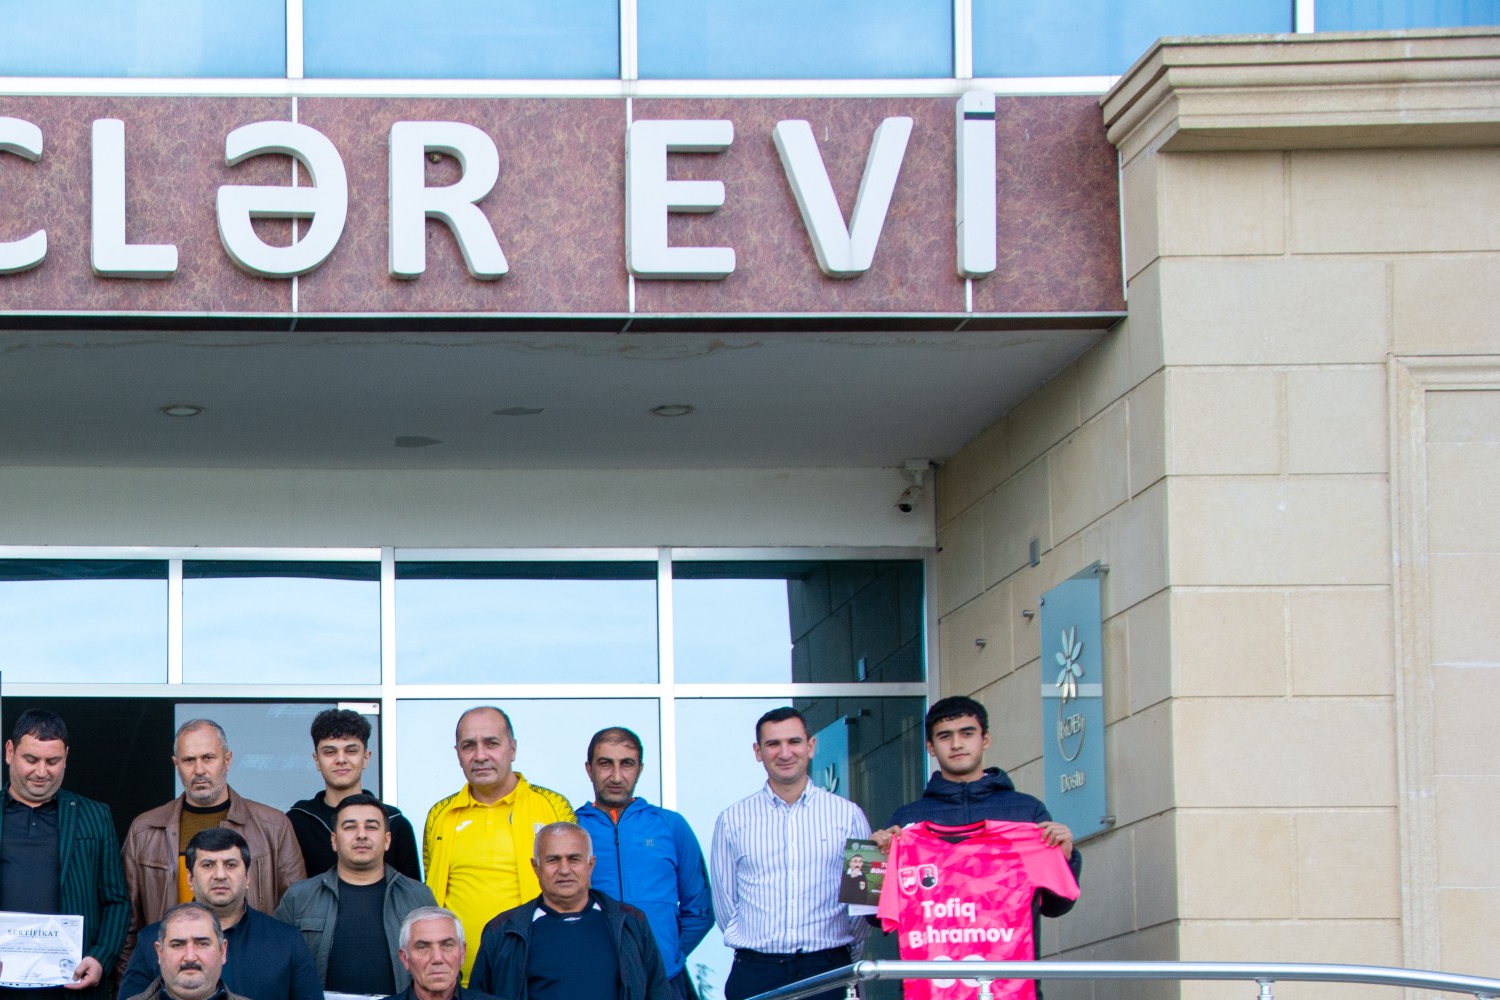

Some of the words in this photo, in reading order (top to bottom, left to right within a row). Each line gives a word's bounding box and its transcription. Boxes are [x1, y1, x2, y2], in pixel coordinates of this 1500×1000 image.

[626, 91, 997, 280] EVİ
[921, 897, 976, 923] Tofiq
[7, 928, 59, 937] SERTİFİKAT
[908, 925, 1015, 949] Bhramov
